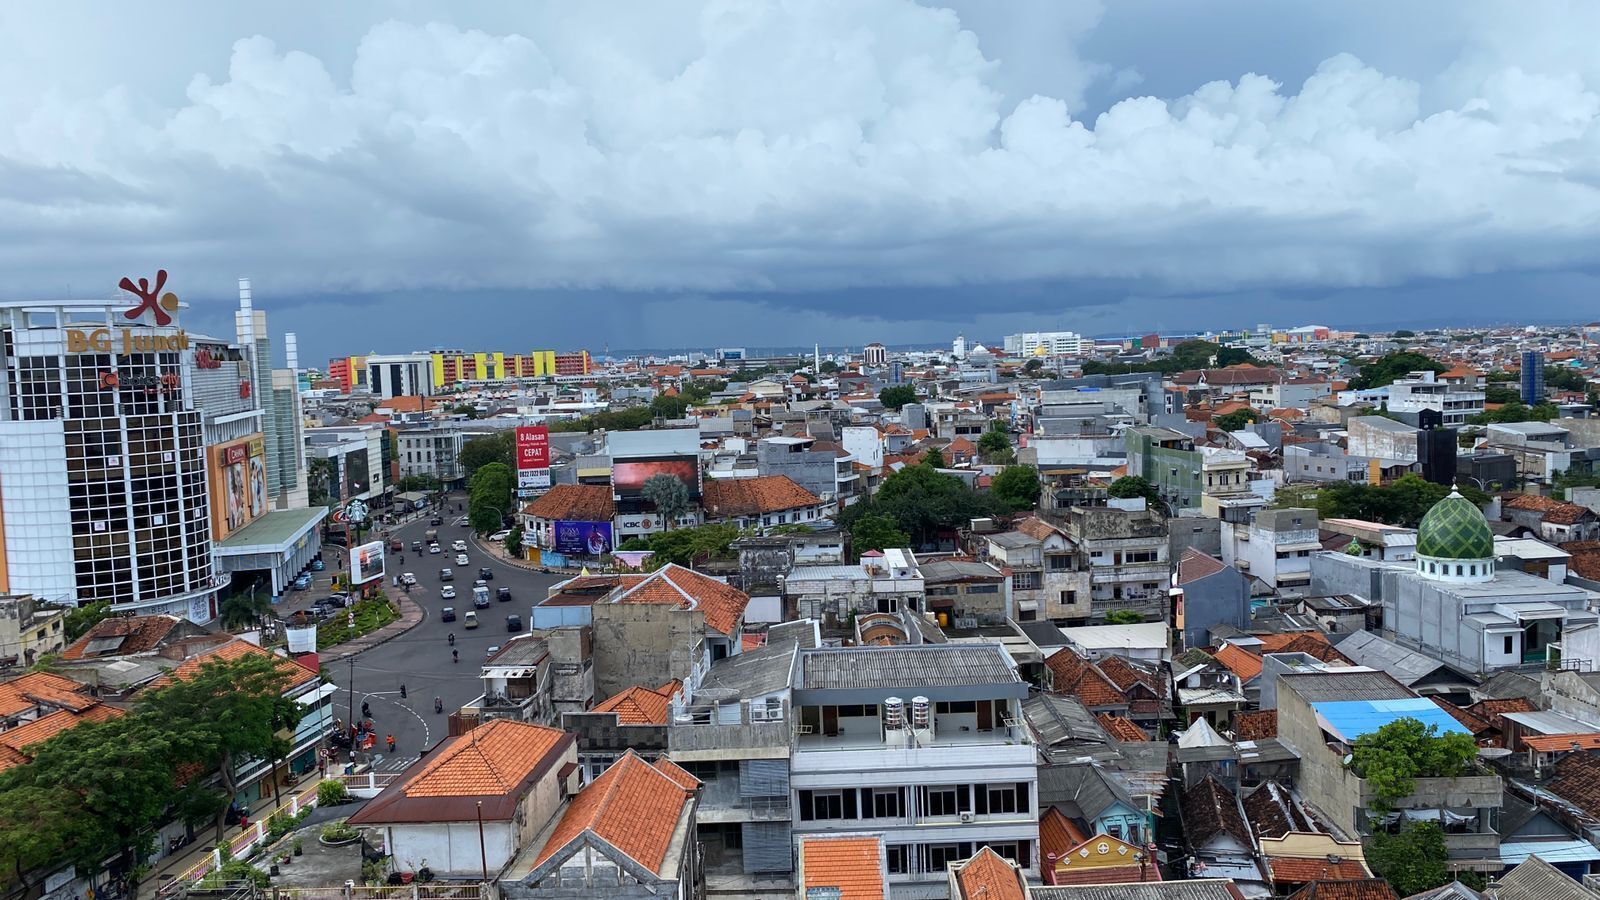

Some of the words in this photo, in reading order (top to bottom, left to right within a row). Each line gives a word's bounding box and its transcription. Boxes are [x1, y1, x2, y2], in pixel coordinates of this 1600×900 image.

[66, 329, 112, 352] BG
[520, 433, 525, 442] 8
[525, 432, 545, 441] Alasan
[524, 448, 542, 457] CEPAT
